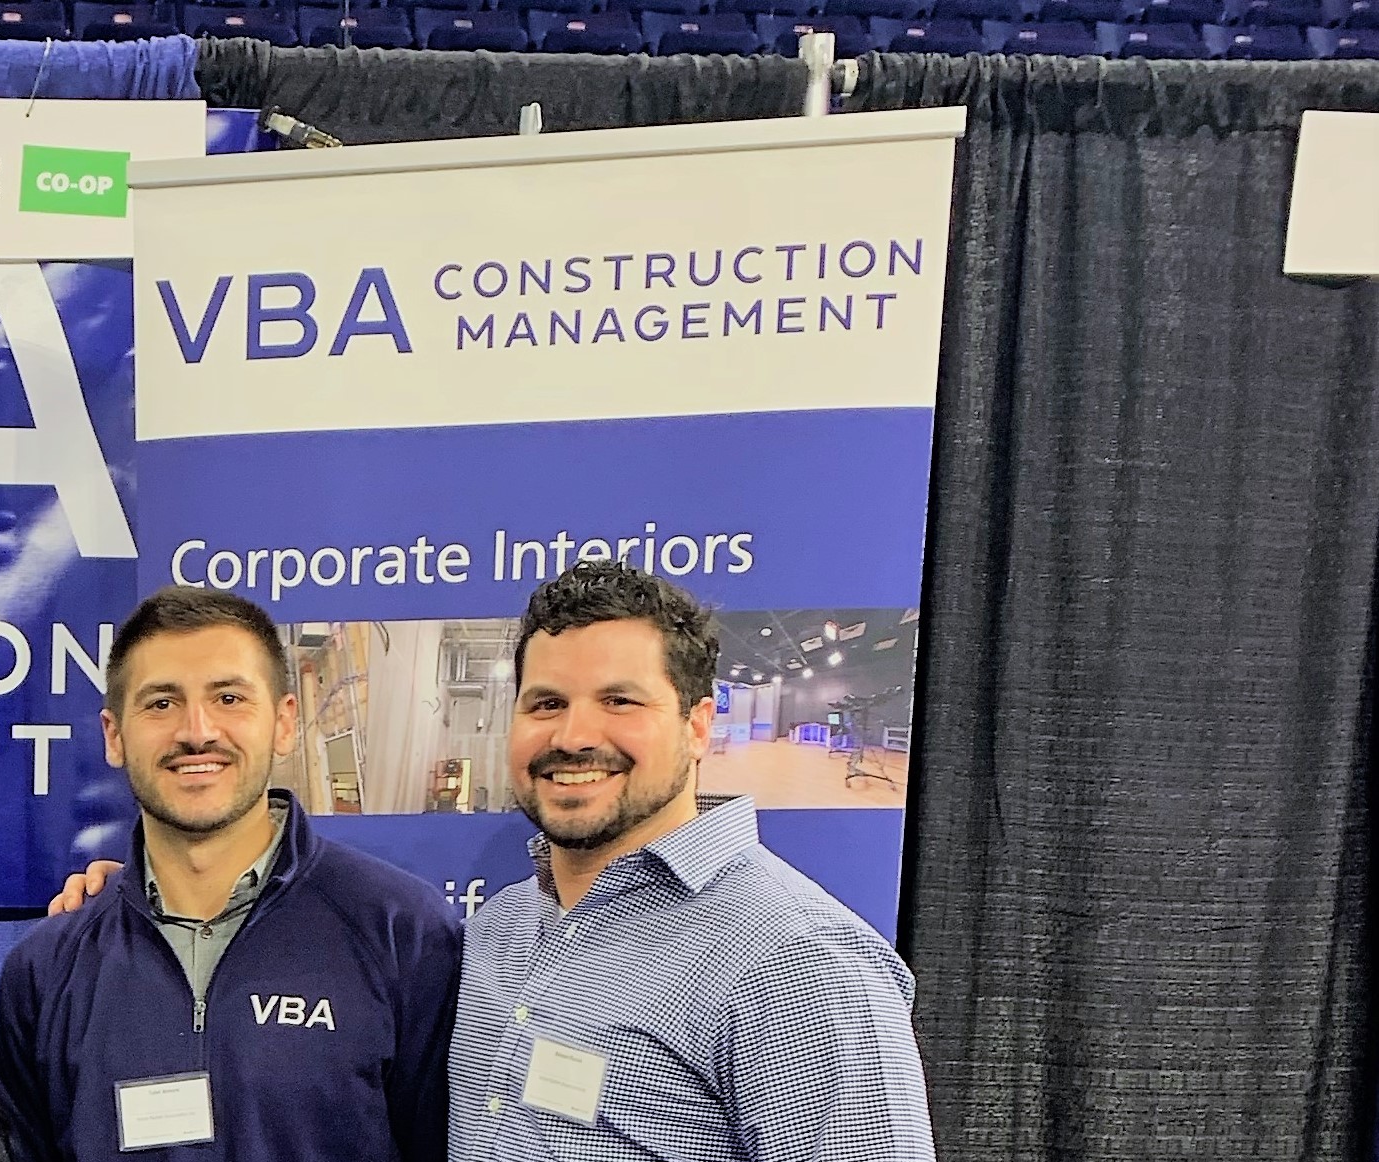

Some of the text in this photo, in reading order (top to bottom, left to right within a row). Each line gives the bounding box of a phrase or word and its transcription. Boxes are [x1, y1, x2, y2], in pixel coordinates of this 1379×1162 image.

[35, 172, 114, 197] CO-OP
[155, 239, 923, 364] VBA CONSTRUCTION
[456, 293, 897, 351] MANAGEMENT
[170, 521, 755, 602] Corporate Interiors
[250, 994, 336, 1031] VBA
